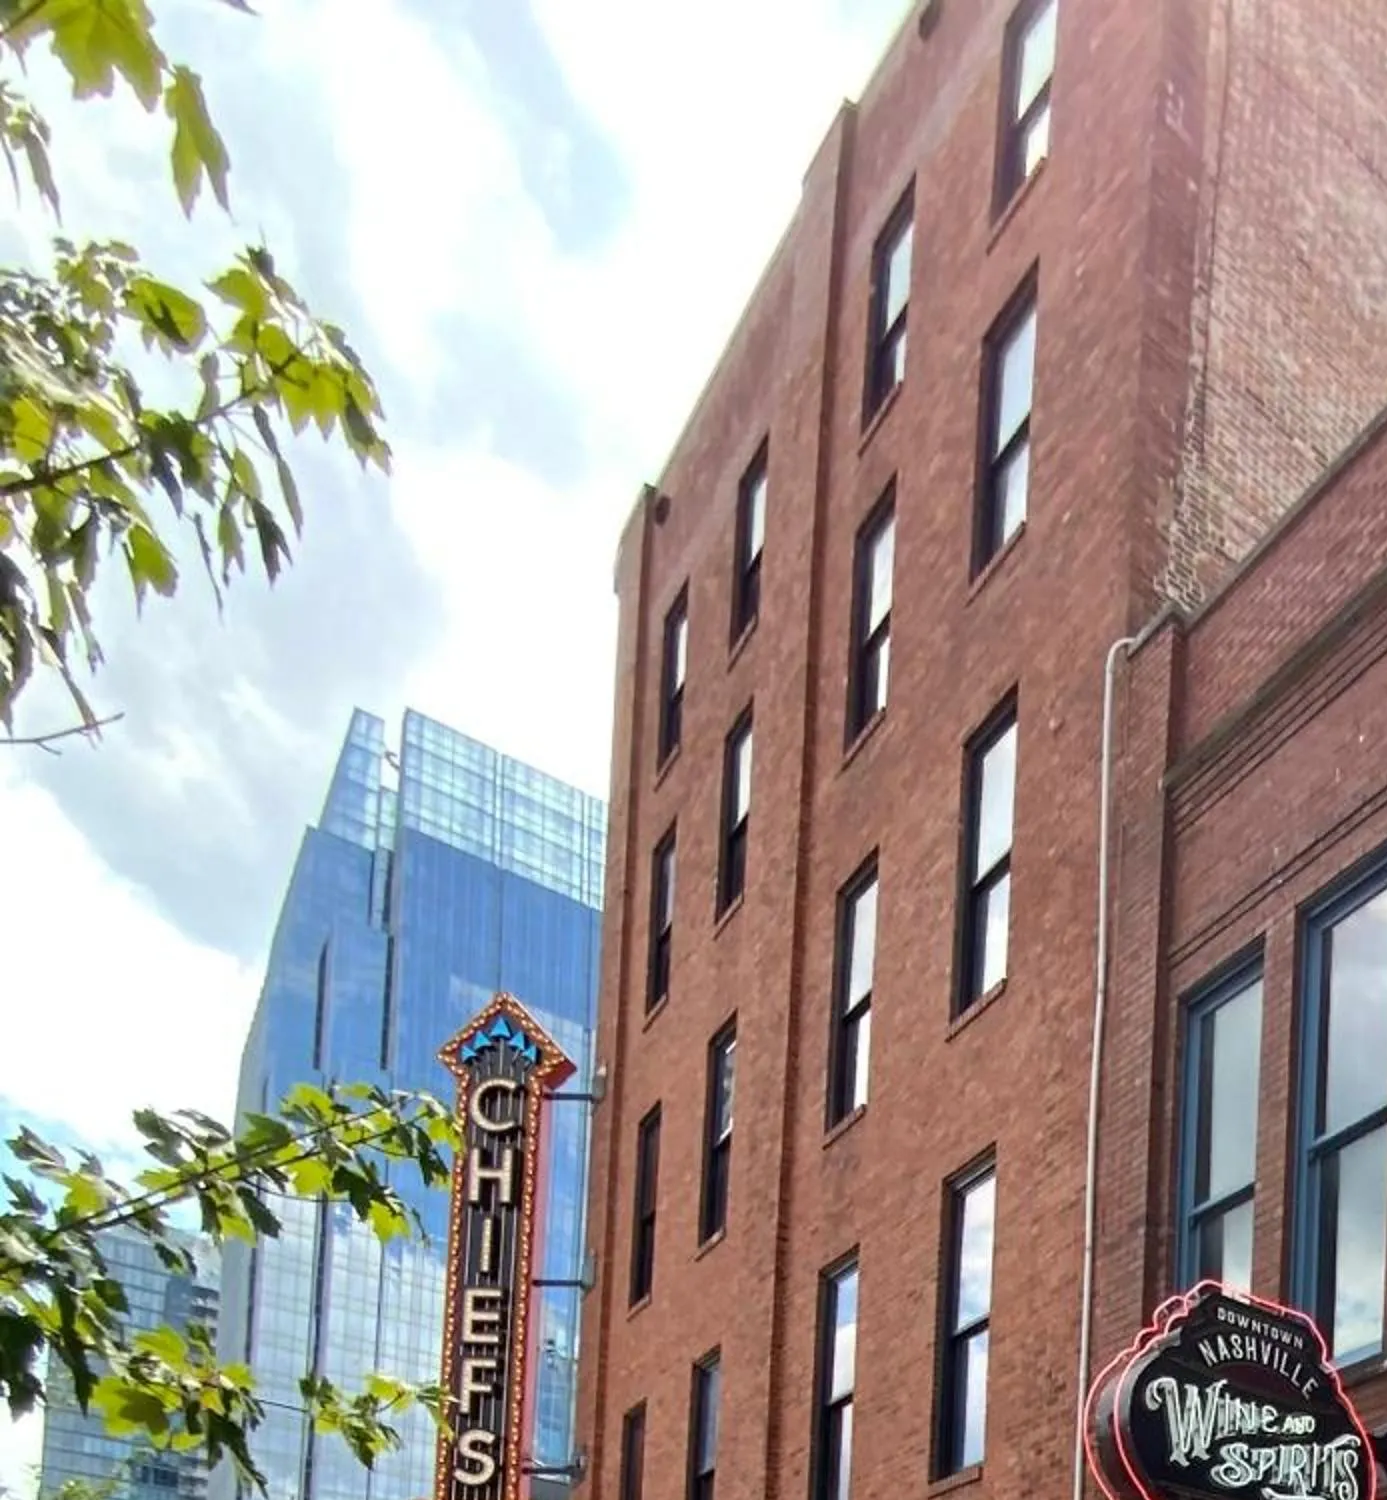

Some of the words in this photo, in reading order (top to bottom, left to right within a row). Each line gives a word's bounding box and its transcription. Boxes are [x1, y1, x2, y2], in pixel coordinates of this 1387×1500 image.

[453, 1078, 519, 1486] CHIEFS
[1217, 1306, 1304, 1349] DOWNTOWN
[1199, 1334, 1320, 1402] NASHVILLE
[1145, 1376, 1278, 1467] WINE
[1282, 1413, 1316, 1436] AND
